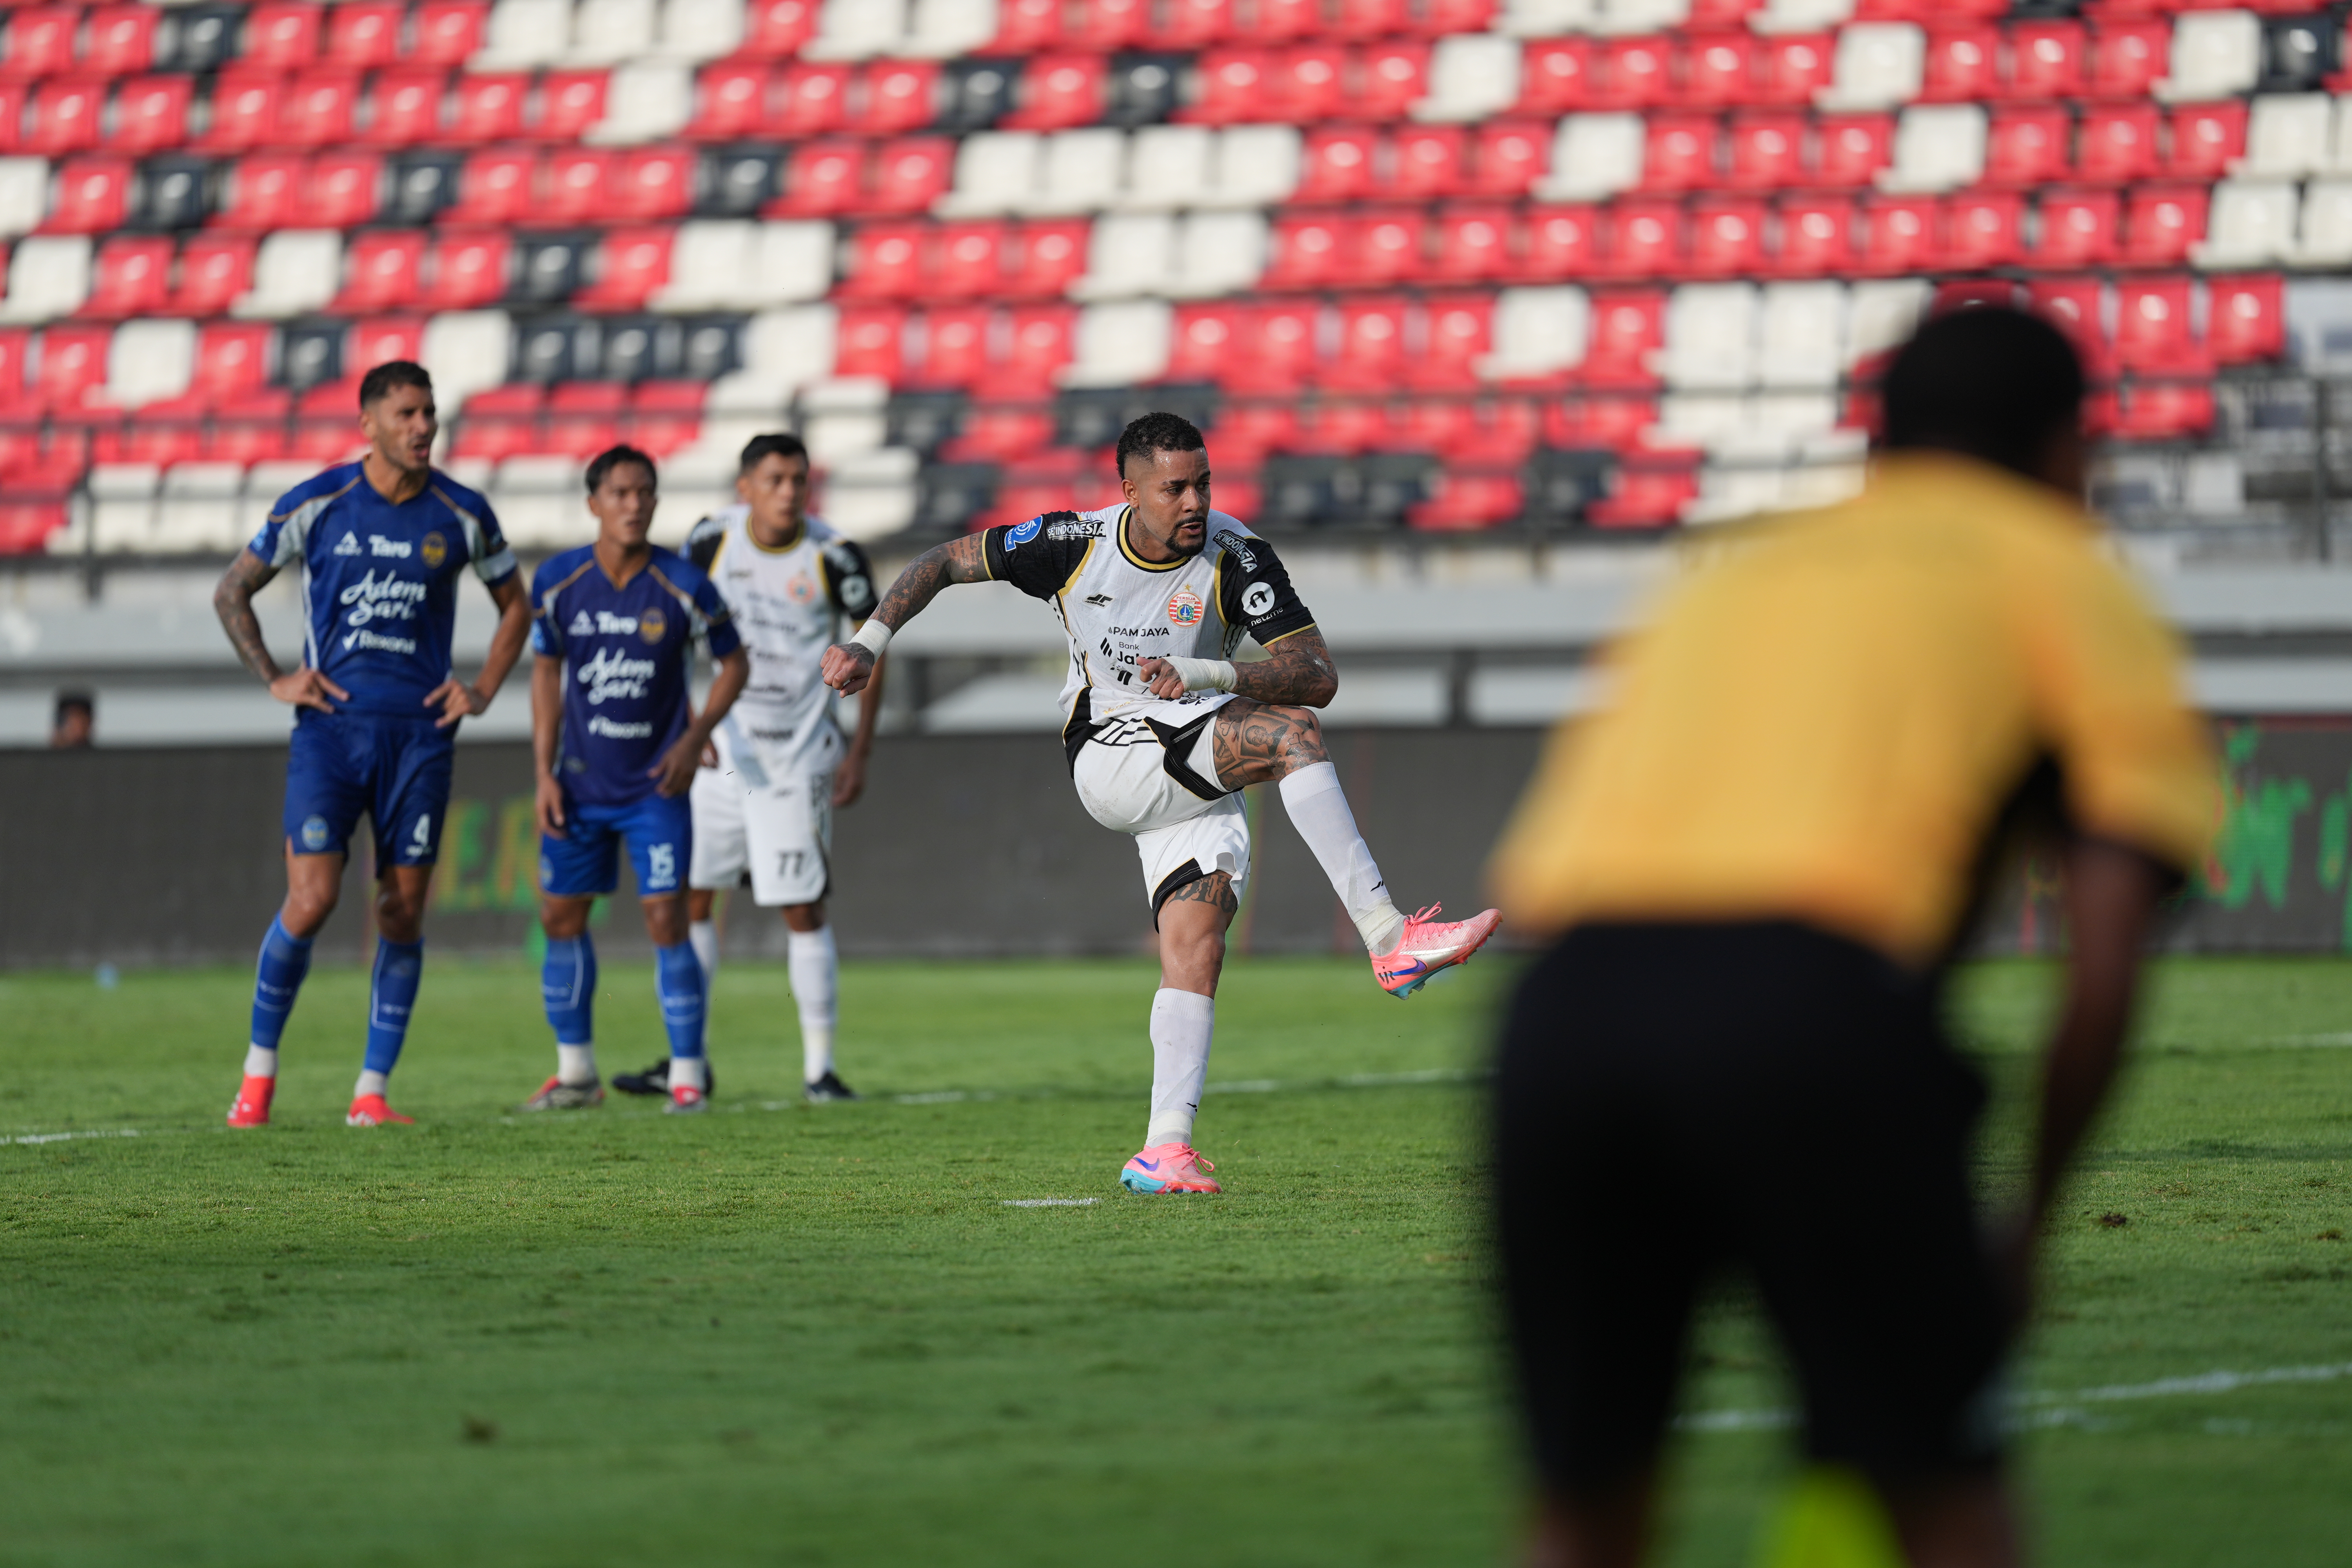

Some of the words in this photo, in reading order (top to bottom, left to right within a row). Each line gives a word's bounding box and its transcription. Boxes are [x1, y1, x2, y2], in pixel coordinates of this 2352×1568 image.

[339, 568, 427, 605] Adem
[1251, 607, 1284, 626] netzme
[1113, 626, 1138, 637] PAM
[1141, 627, 1170, 637] JAYA
[1119, 642, 1140, 650] Bank
[413, 813, 431, 848] 4
[648, 842, 675, 877] 15
[777, 849, 805, 878] 77
